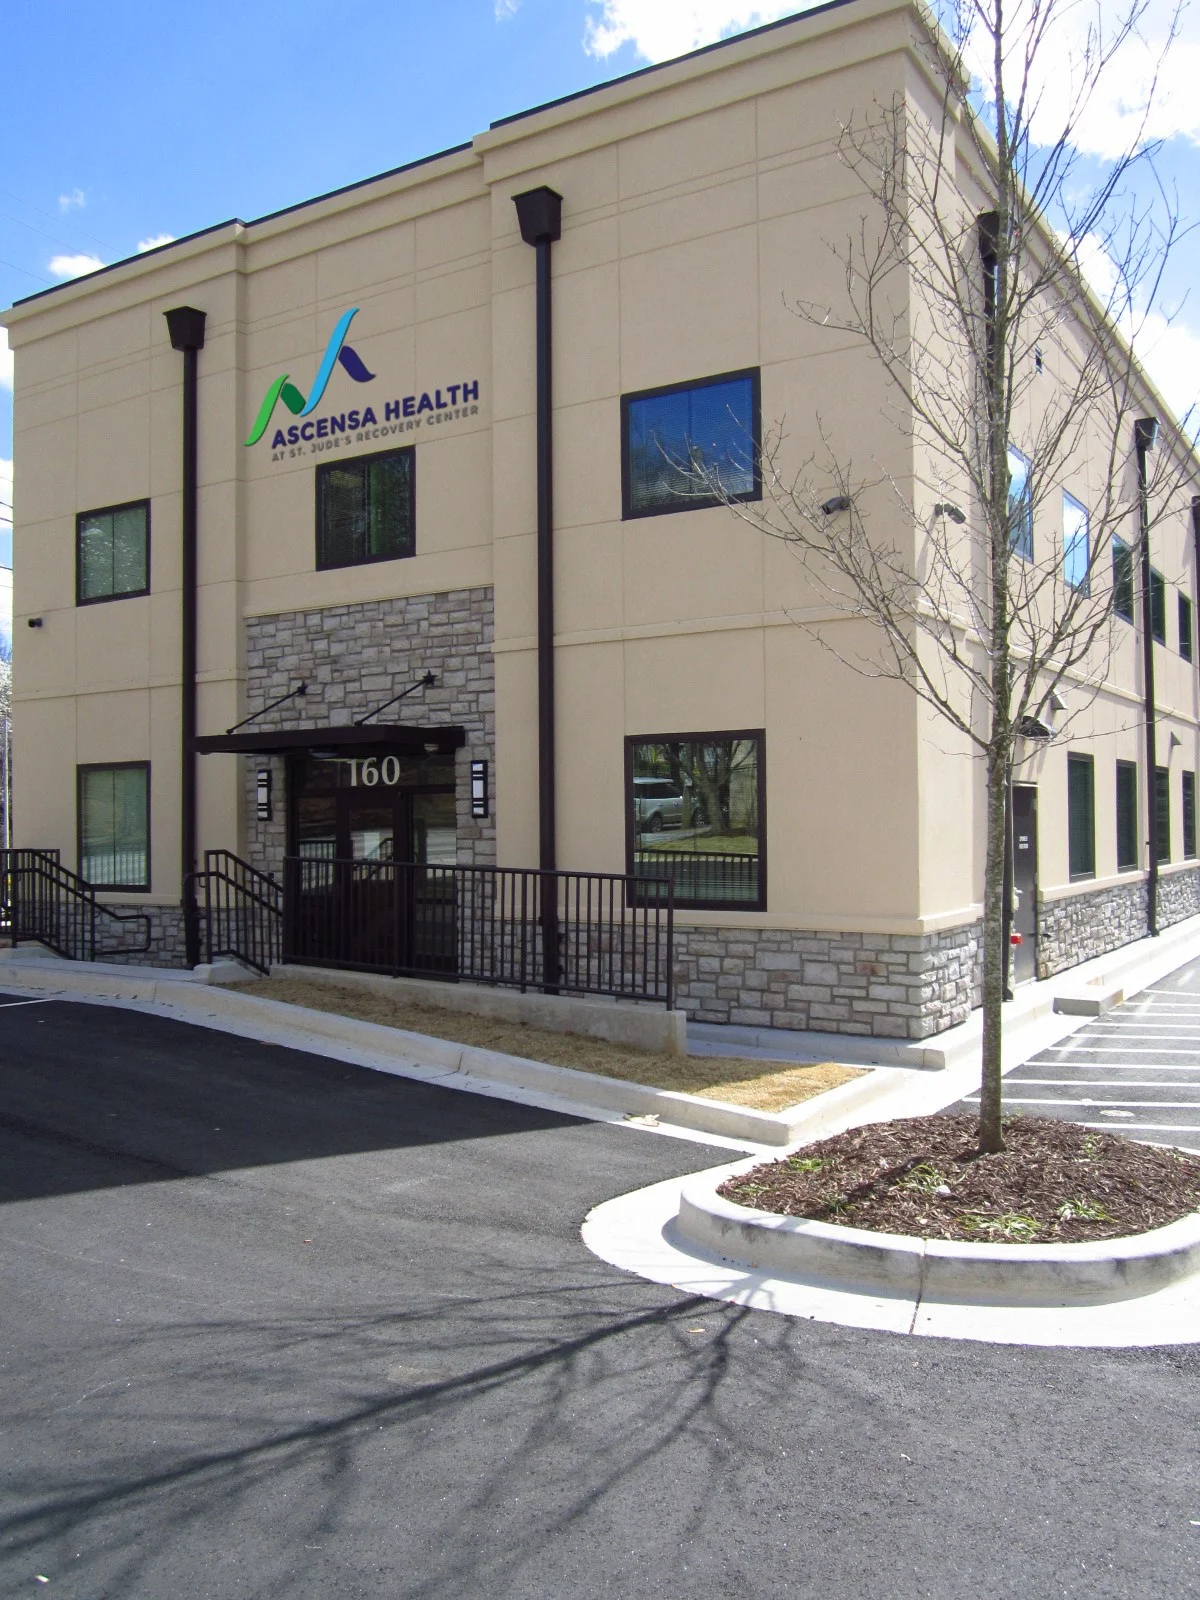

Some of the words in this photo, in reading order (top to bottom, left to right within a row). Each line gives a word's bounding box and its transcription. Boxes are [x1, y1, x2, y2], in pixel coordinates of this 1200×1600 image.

[271, 407, 377, 449] ASCENSA
[384, 380, 479, 421] HEALTH
[272, 450, 285, 462] AT
[289, 446, 306, 458] ST.
[311, 435, 351, 453] JUDE'S
[356, 419, 421, 442] RECOVERY
[426, 405, 478, 426] CENTER
[346, 755, 400, 787] 160
